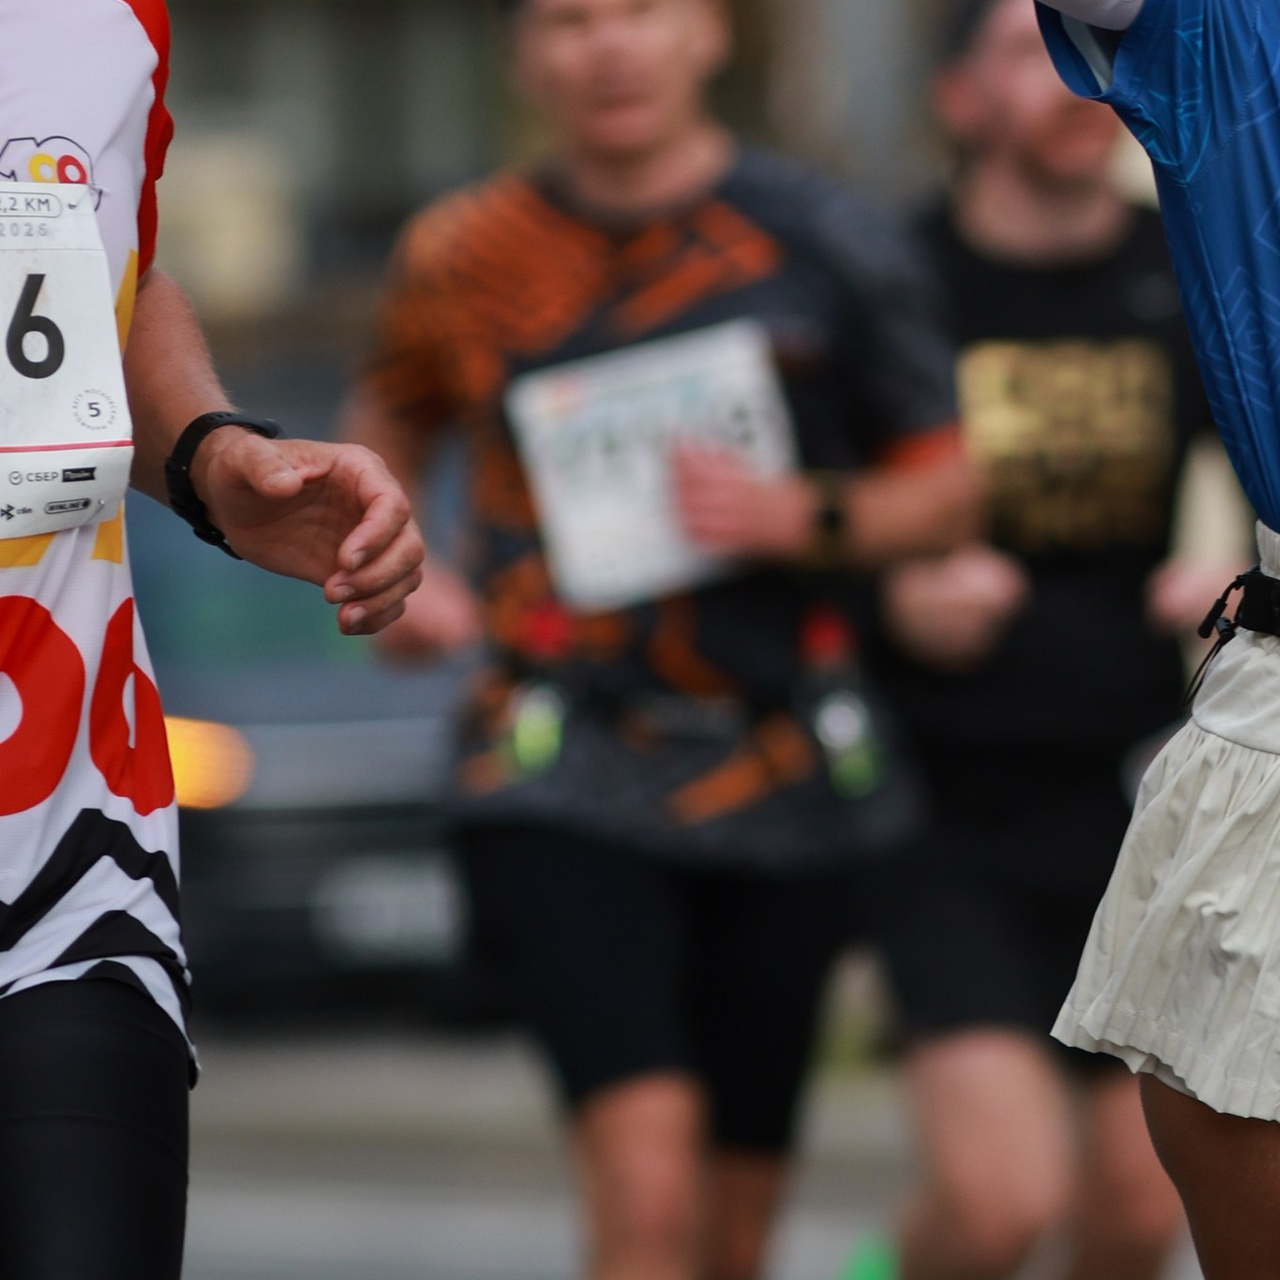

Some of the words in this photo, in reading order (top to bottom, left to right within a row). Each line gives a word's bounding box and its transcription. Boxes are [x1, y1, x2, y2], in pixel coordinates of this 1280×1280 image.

[5, 273, 65, 379] 6
[88, 401, 101, 418] 5
[26, 471, 59, 482] СБЕР
